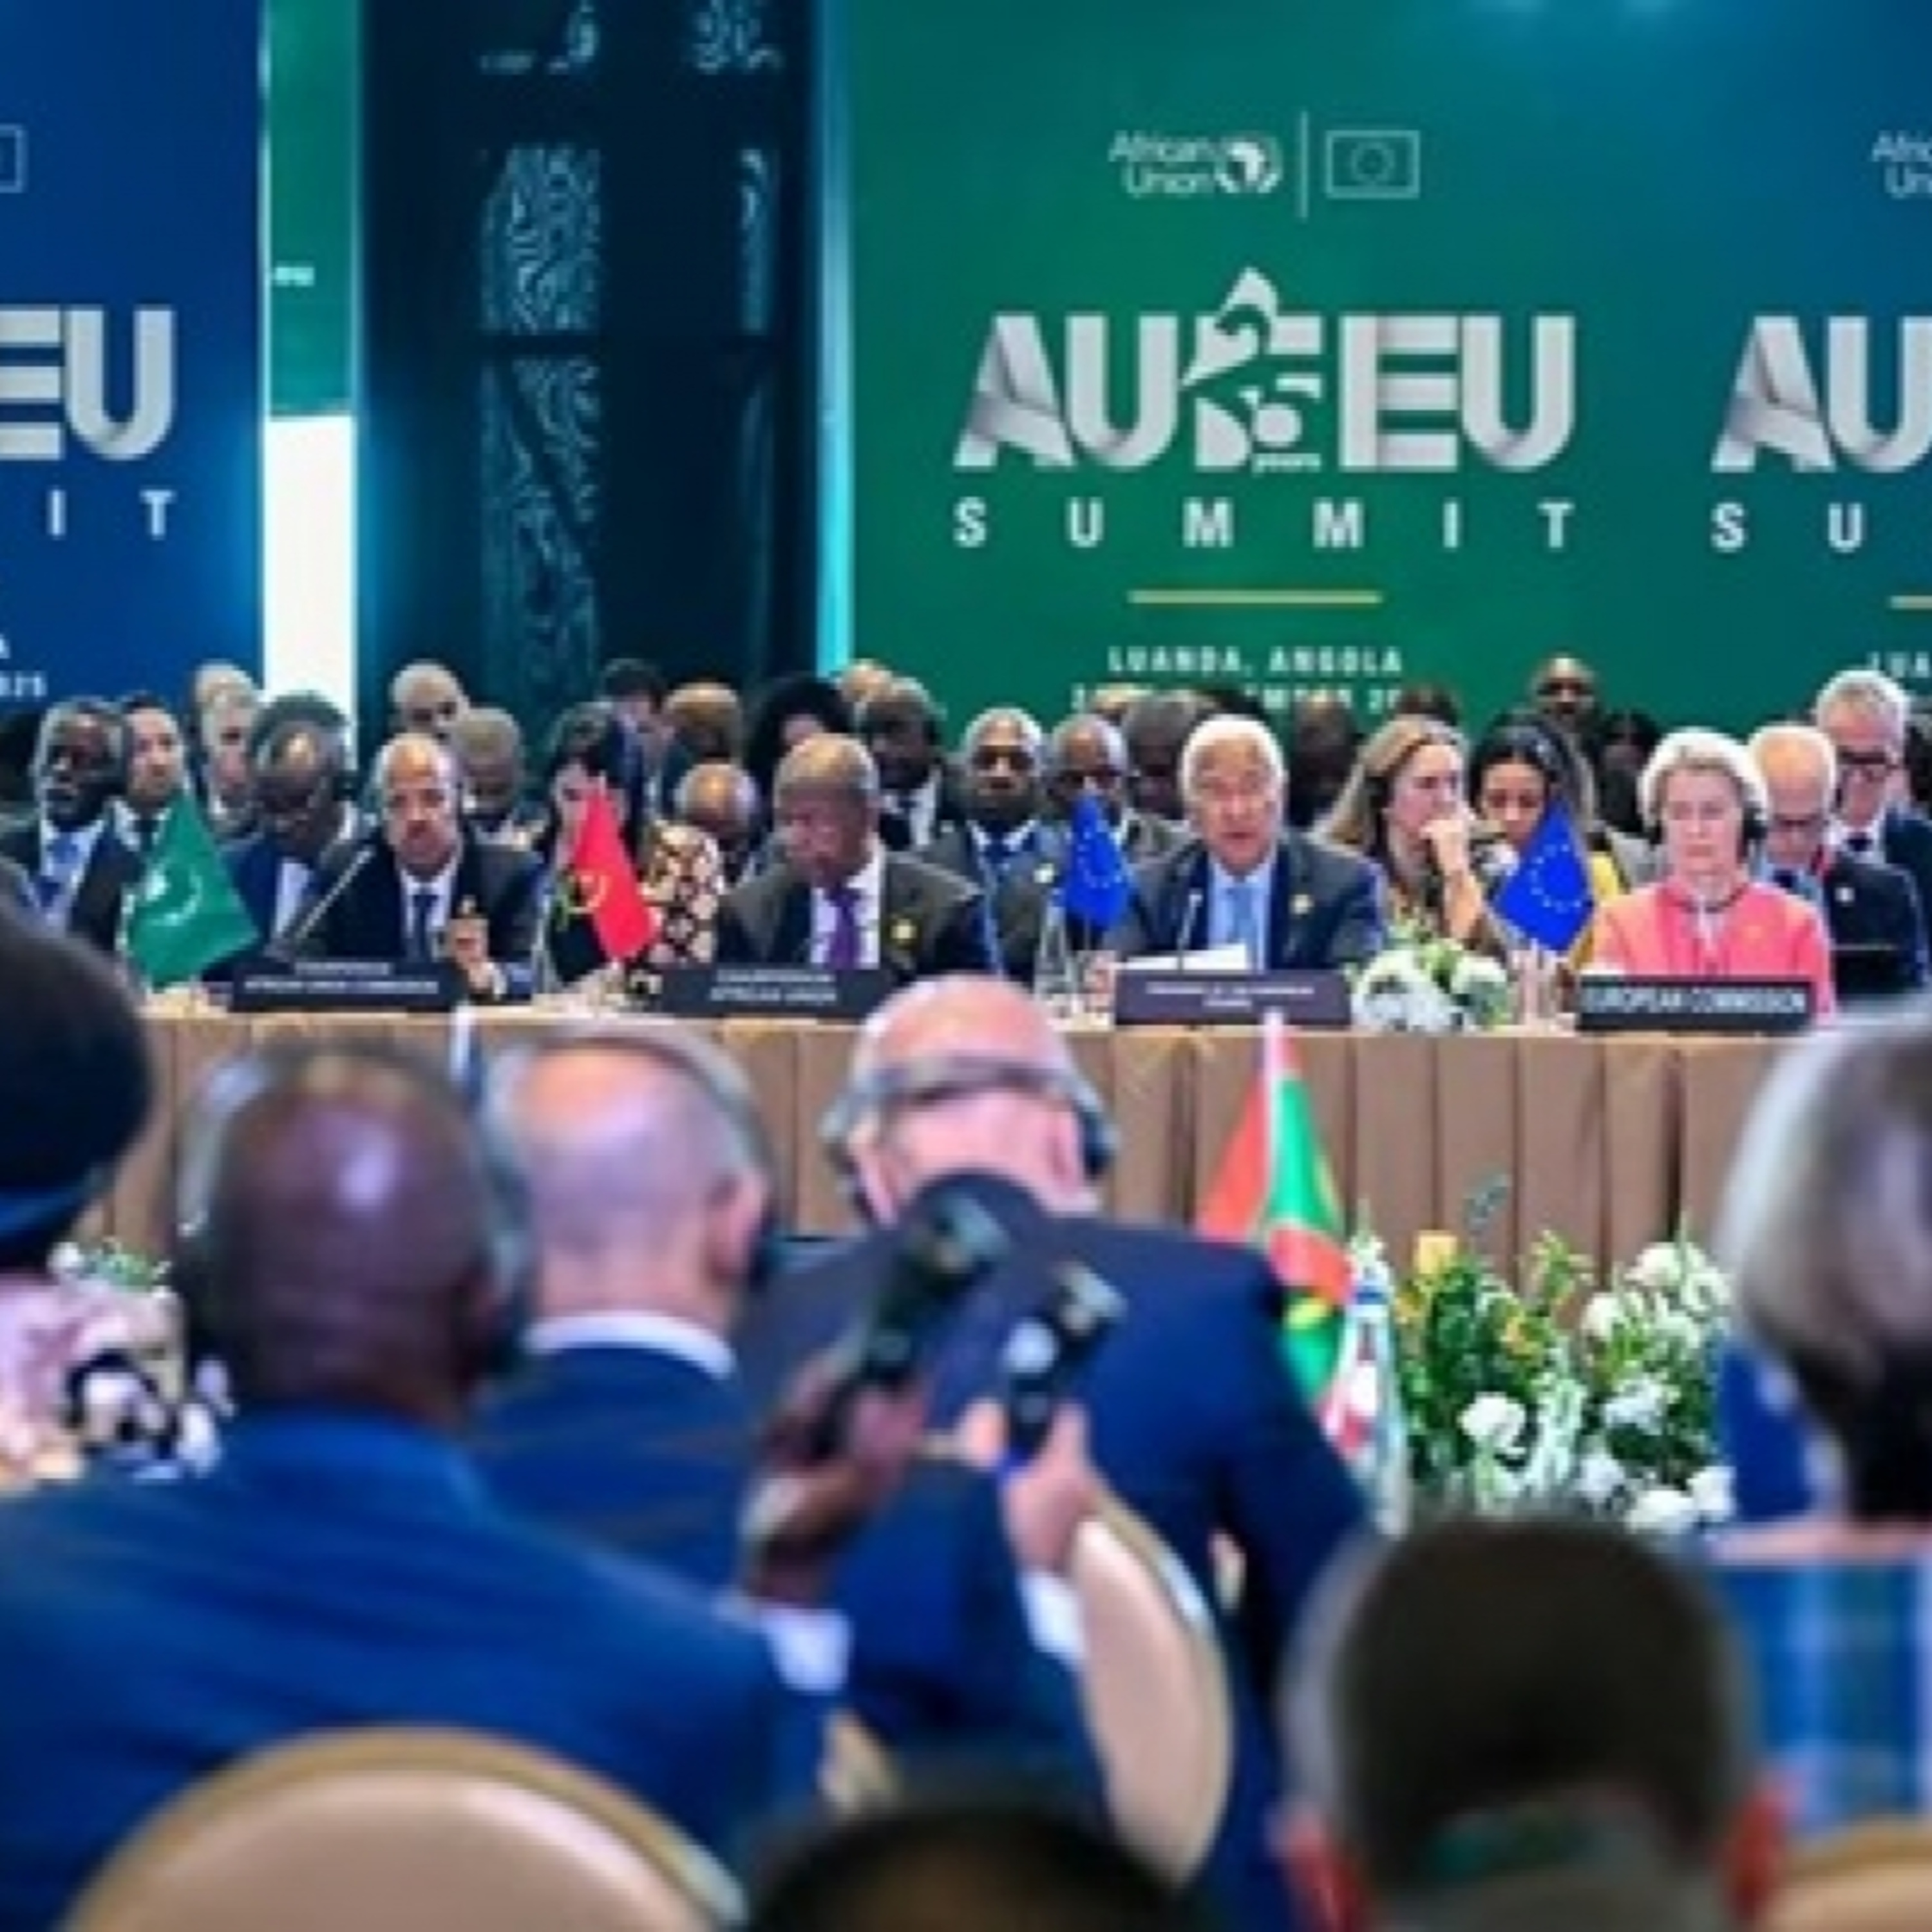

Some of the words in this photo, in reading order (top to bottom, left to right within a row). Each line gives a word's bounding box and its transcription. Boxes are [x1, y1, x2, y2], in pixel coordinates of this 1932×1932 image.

[1108, 130, 1216, 163] African
[1121, 166, 1213, 198] Union
[1710, 313, 1932, 474] AU
[953, 497, 1575, 550] SUMMIT
[1106, 645, 1255, 676] LUANDA,
[1269, 645, 1403, 674] ANGOLA
[1583, 985, 1682, 1014] EUROPEAN
[1688, 985, 1806, 1014] COMMISSION
